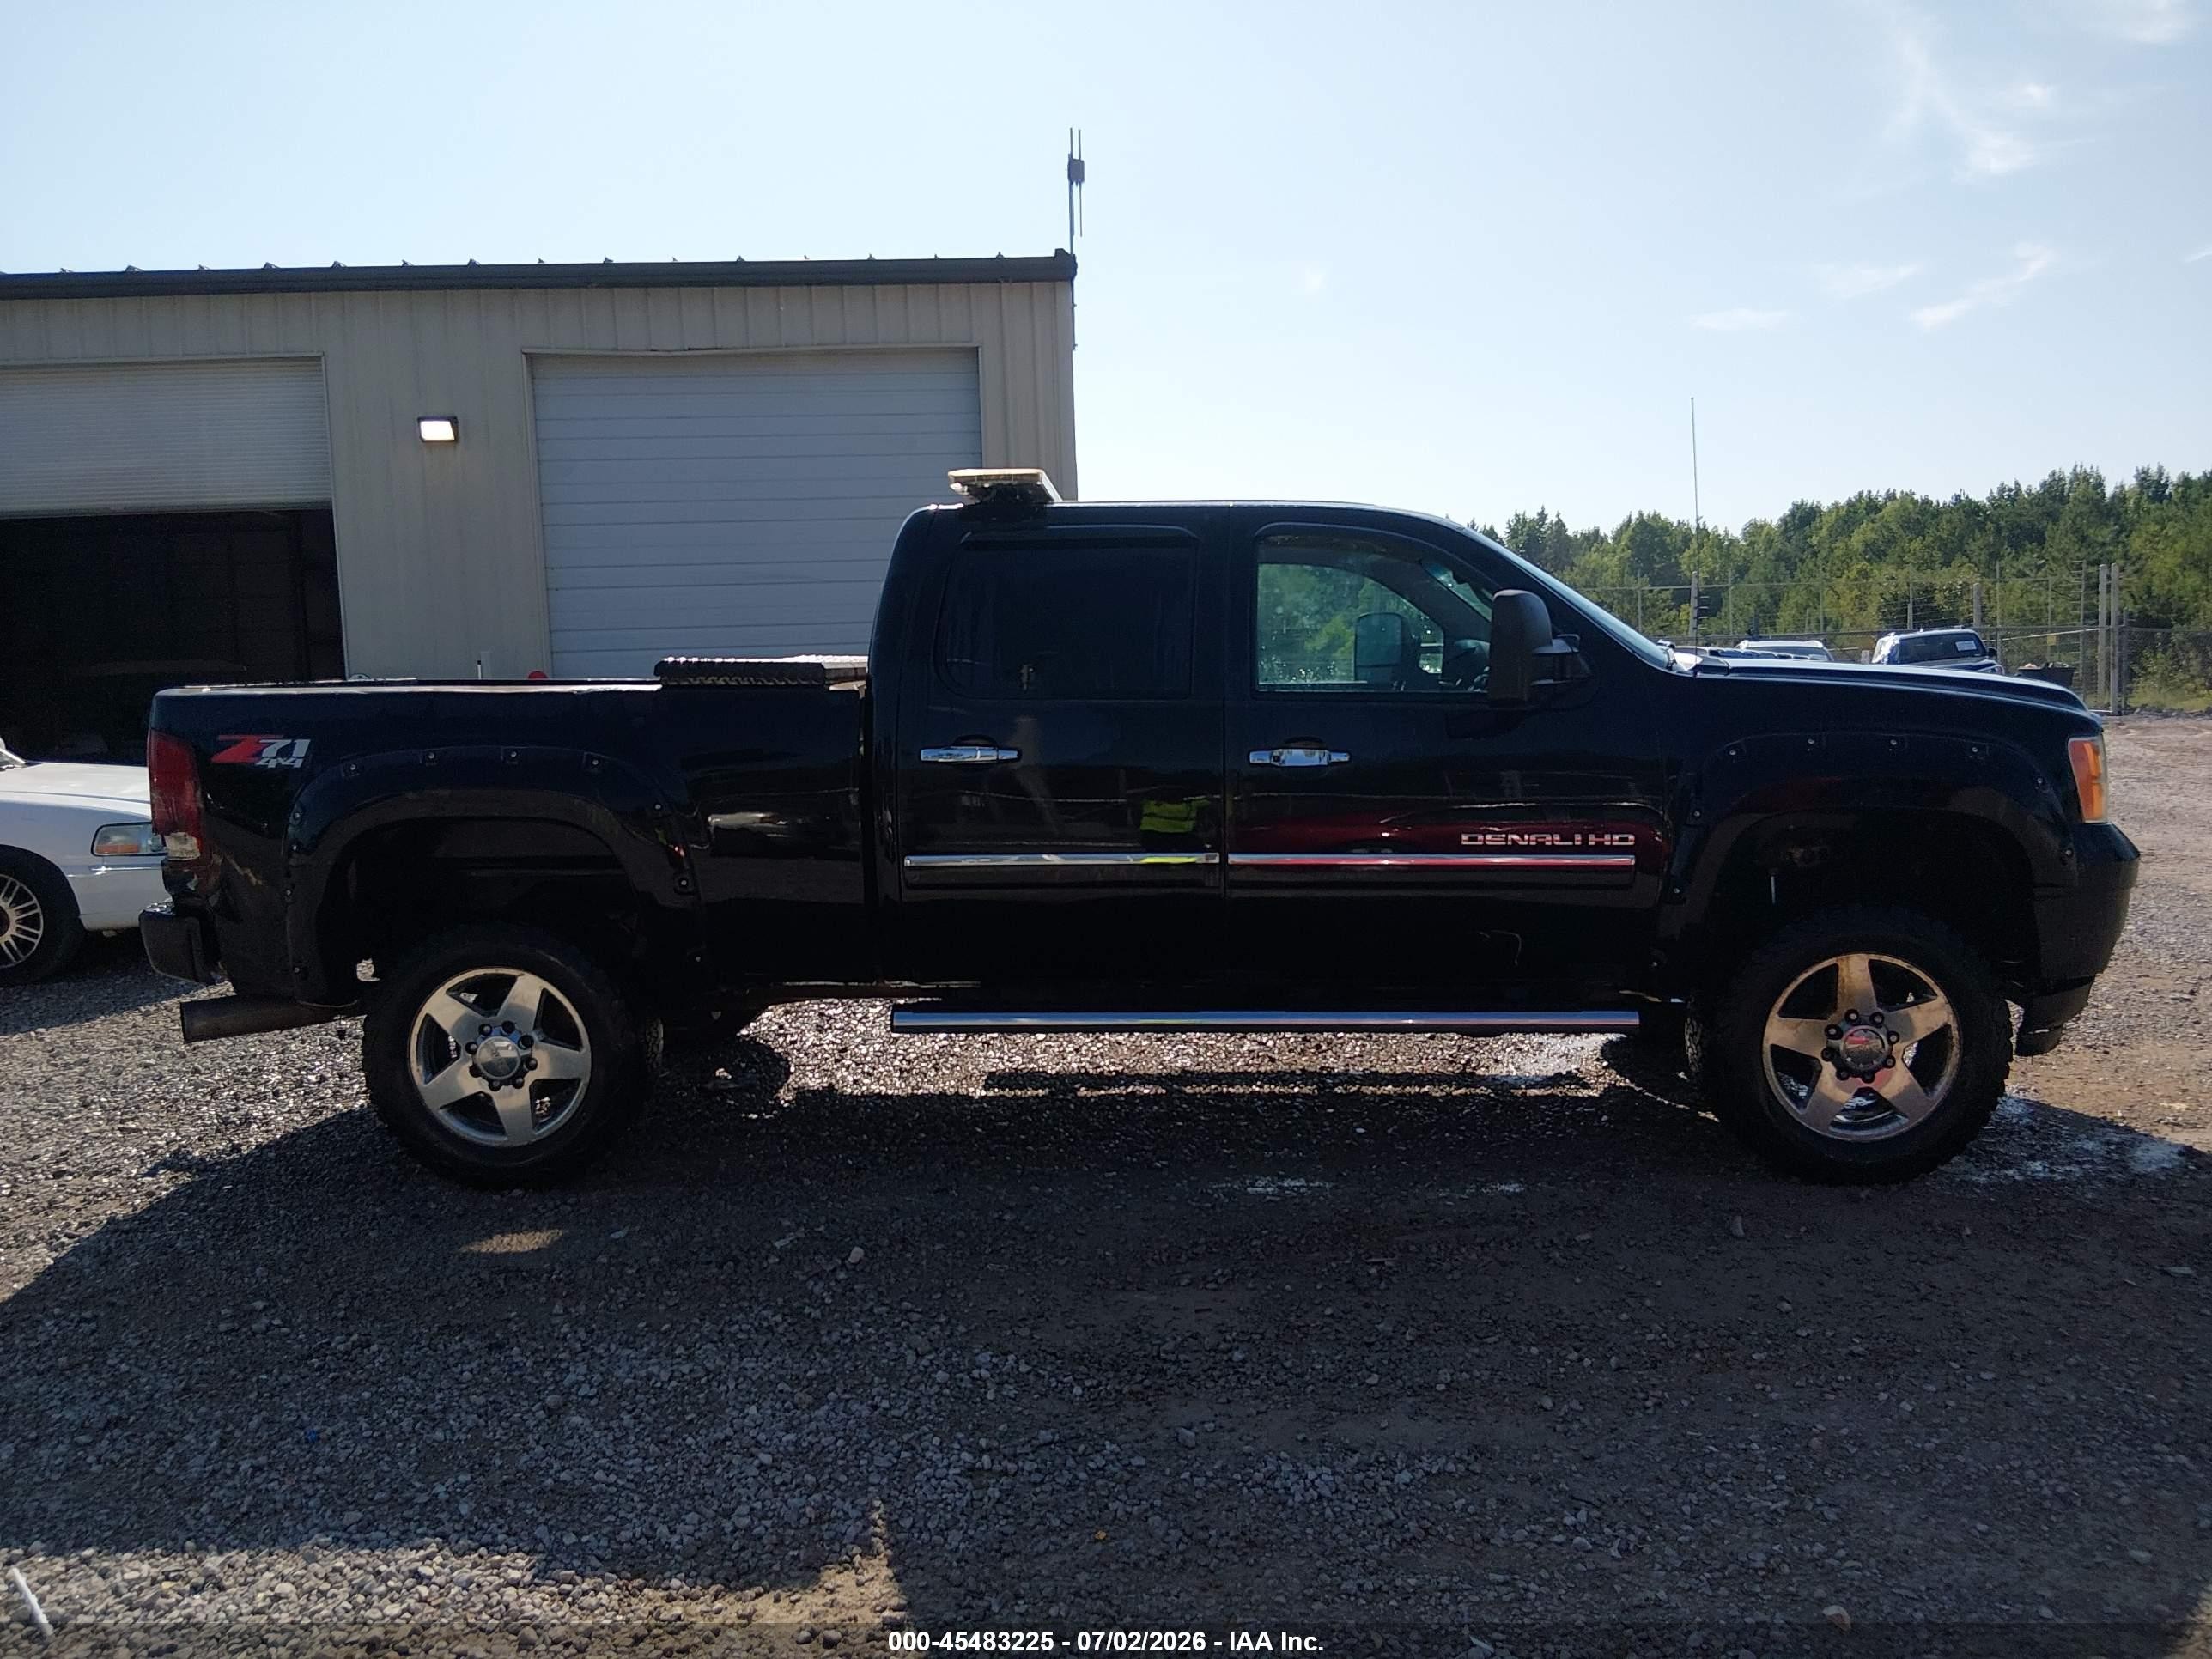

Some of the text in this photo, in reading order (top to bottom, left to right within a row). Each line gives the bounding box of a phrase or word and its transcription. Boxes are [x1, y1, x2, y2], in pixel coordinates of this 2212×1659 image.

[210, 734, 311, 764] Z71
[1461, 833, 1636, 846] DENALI HD
